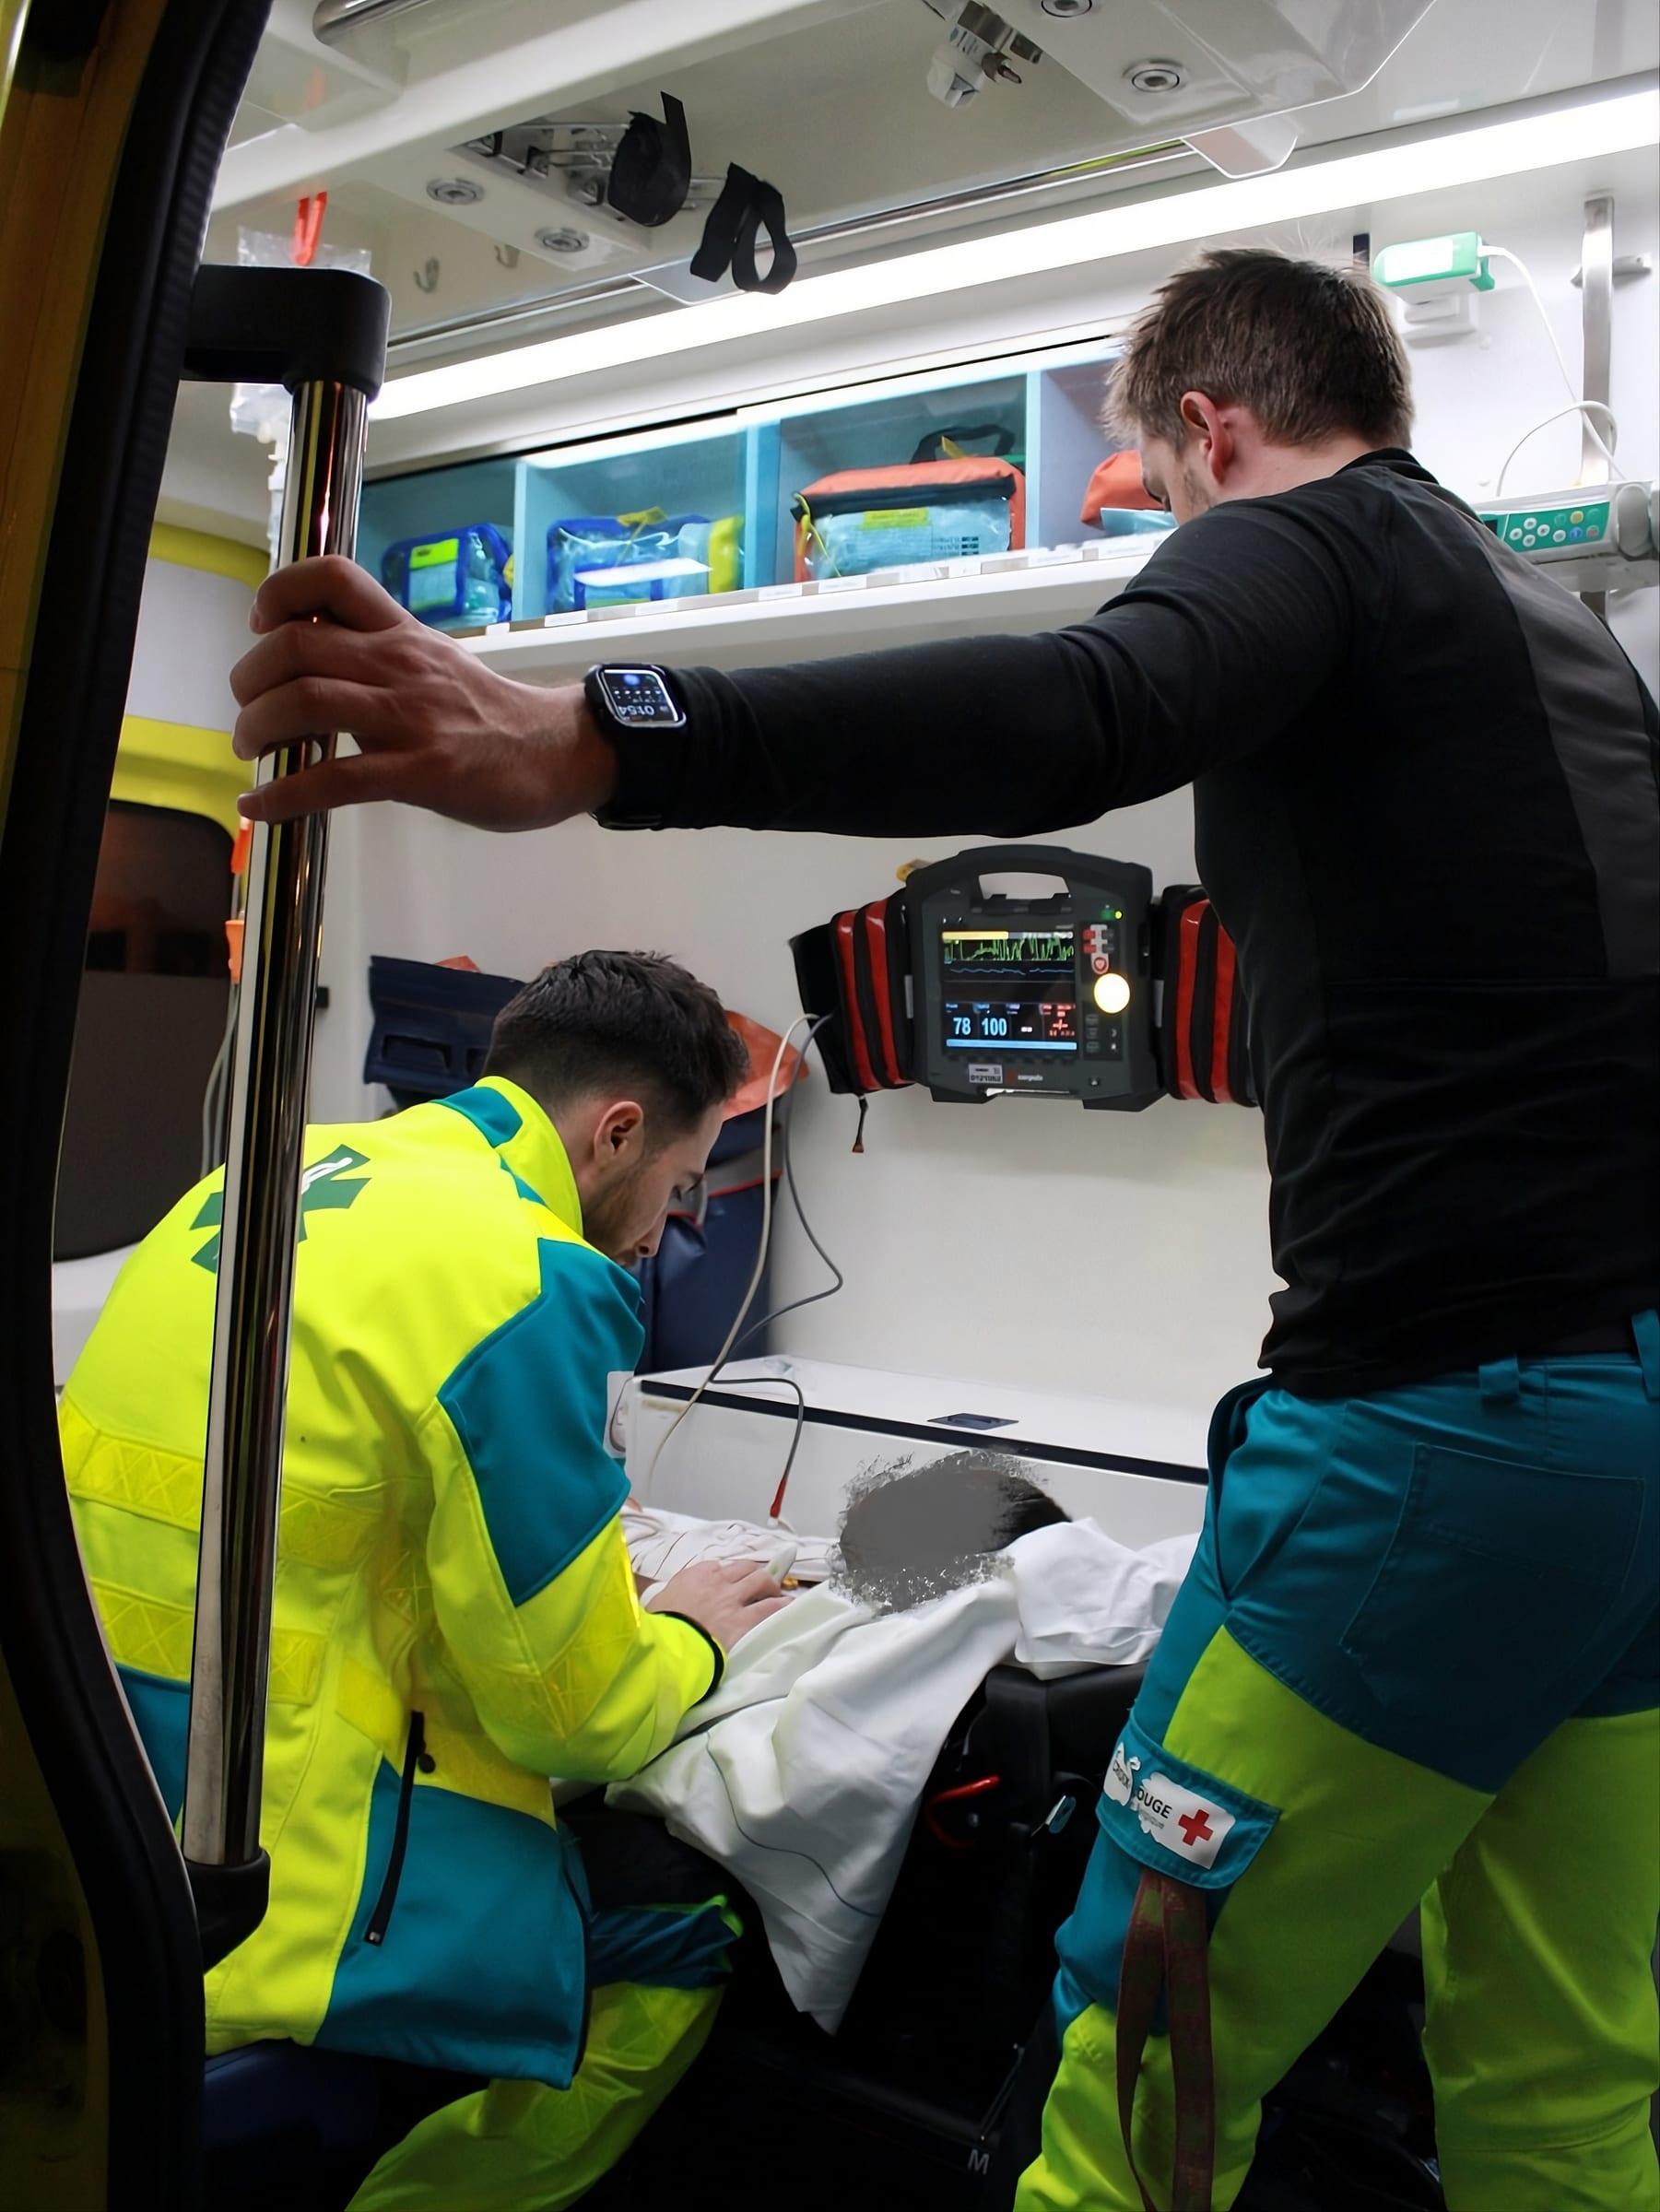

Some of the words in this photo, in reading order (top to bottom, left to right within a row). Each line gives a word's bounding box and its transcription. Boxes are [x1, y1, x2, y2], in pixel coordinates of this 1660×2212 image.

[953, 1017, 971, 1036] 78
[981, 1017, 1007, 1036] 100
[1136, 1787, 1173, 1819] OUGE
[967, 2148, 990, 2175] M
